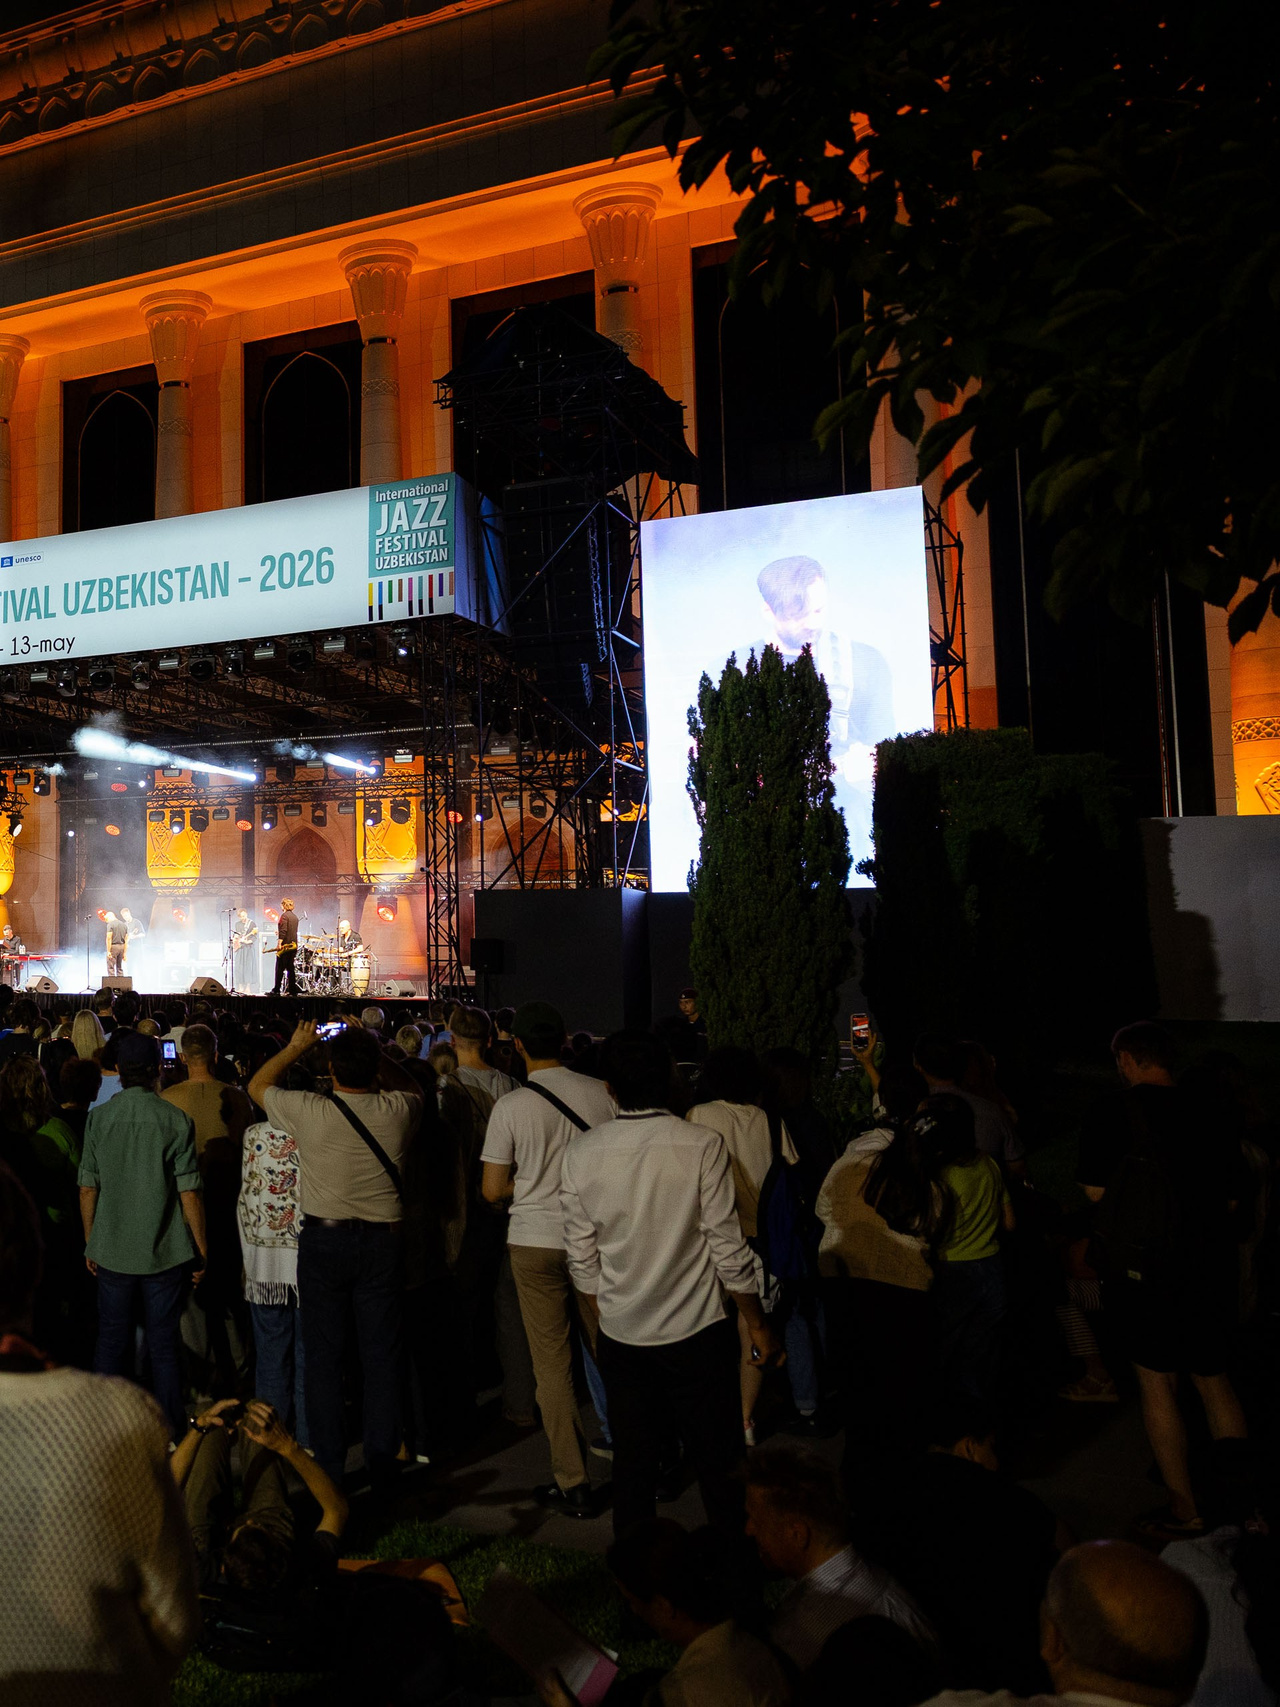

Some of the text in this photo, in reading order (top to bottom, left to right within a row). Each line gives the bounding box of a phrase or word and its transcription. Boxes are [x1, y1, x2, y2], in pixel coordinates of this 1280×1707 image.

[375, 479, 449, 503] International
[375, 494, 447, 536] JAZZ
[375, 529, 448, 555] FESTIVAL
[15, 554, 42, 564] unesco
[375, 548, 448, 570] UZBEKISTAN
[63, 561, 230, 617] UZBEKISTAN
[259, 546, 335, 593] 2026
[10, 635, 76, 656] 13-may
